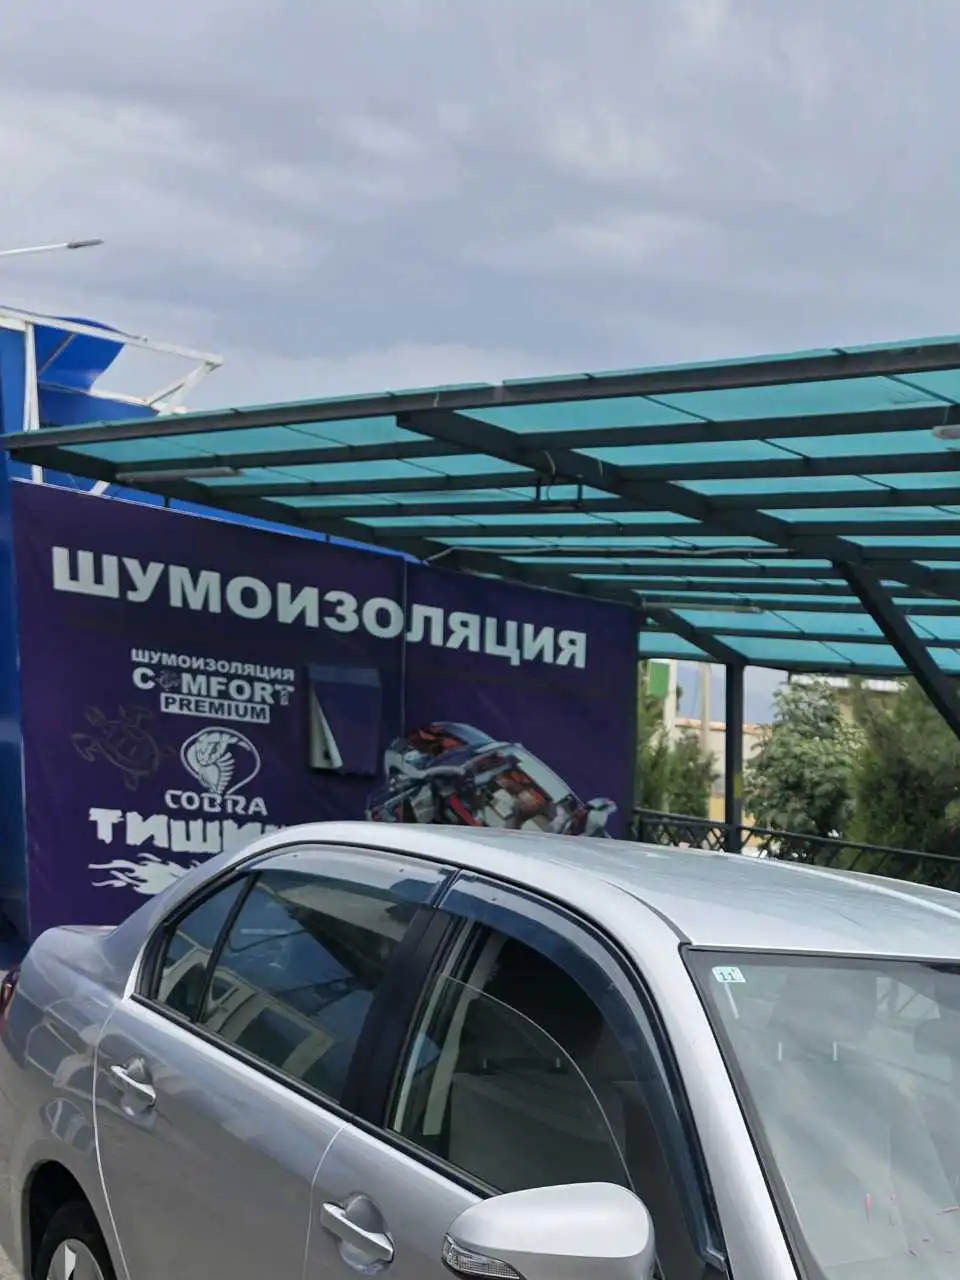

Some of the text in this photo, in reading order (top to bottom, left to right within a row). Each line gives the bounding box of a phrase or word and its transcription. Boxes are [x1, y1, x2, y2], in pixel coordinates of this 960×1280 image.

[51, 546, 587, 669] ШУМОИЗОЛЯЦИЯ
[131, 648, 295, 682] ШУМОИЗОЛЯЦИЯ
[163, 695, 268, 721] PREMIUM
[164, 789, 268, 816] COBRA
[88, 807, 288, 854] ТИШИ
